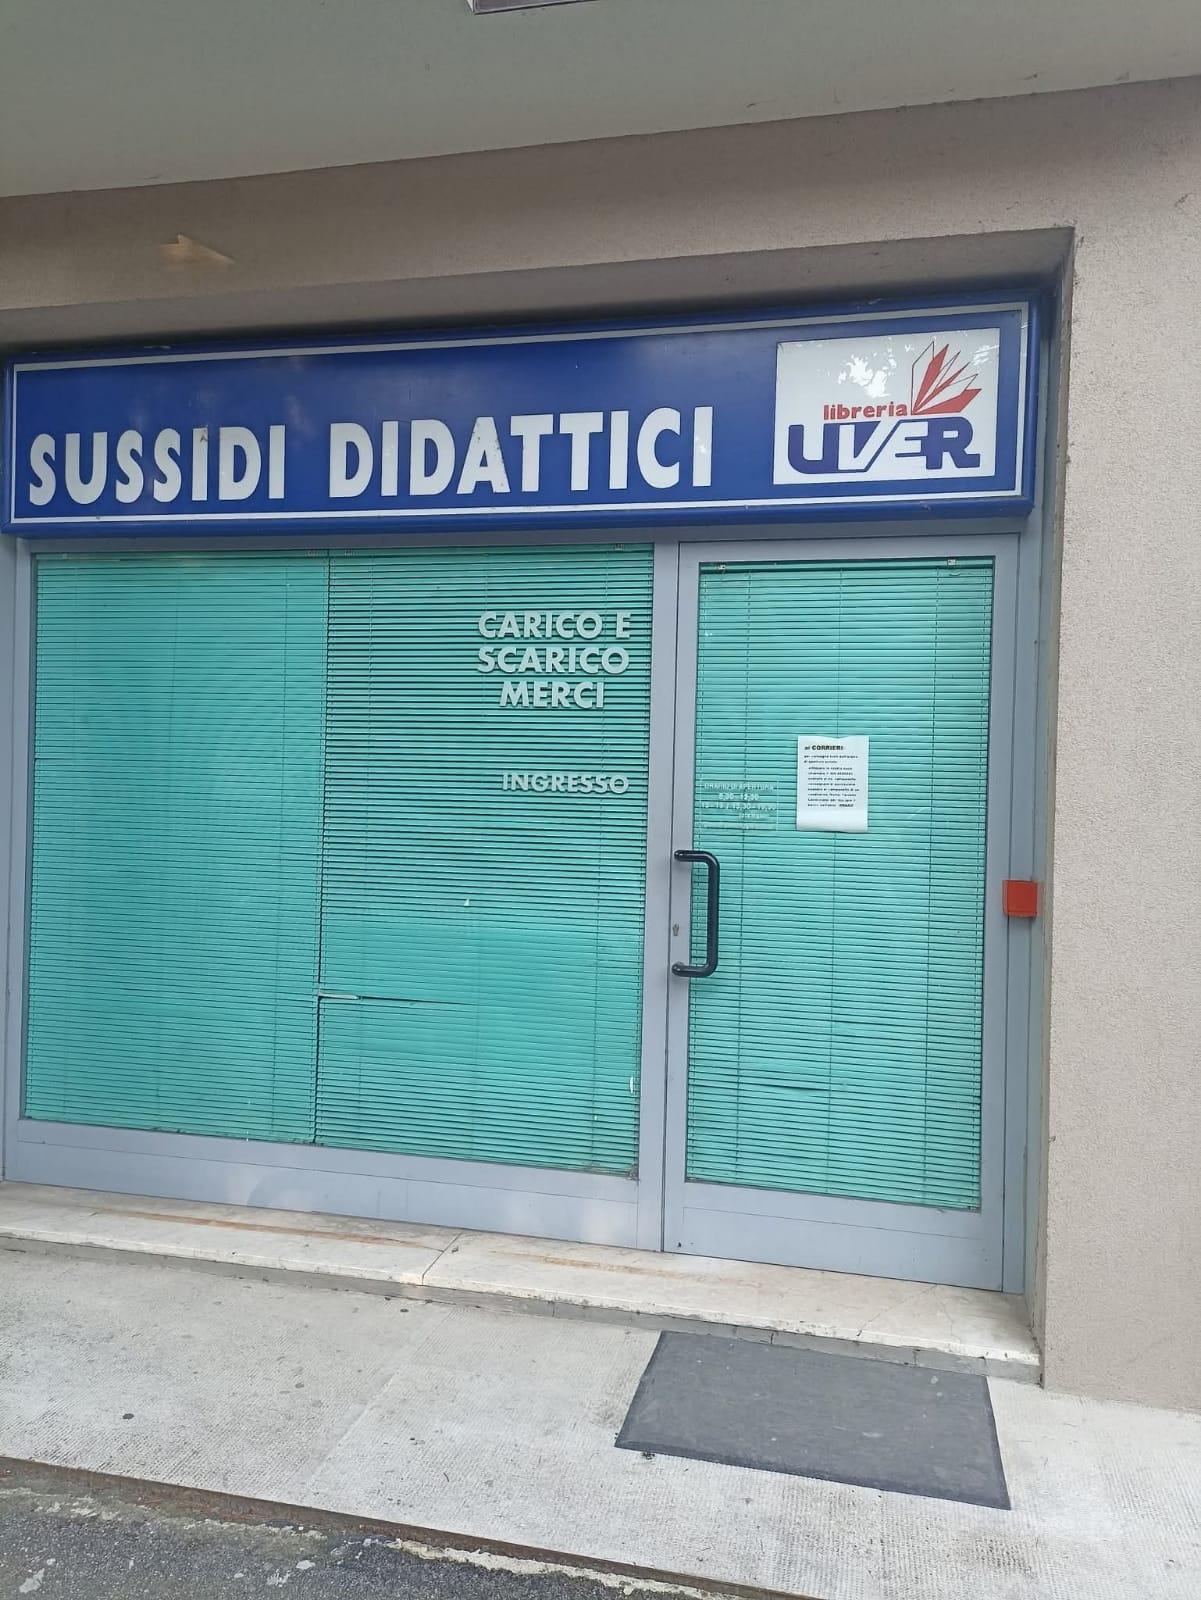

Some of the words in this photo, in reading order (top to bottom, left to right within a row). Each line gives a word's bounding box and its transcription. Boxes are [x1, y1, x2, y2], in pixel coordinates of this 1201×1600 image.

[823, 402, 908, 421] libreria
[29, 424, 286, 506] SUSSIDI
[329, 405, 714, 498] DIDATTICI
[478, 611, 603, 639] CARICO
[615, 611, 632, 638] E
[477, 646, 630, 675] SCARICO
[500, 681, 605, 709] MERCI
[502, 772, 630, 794] INGRESSO
